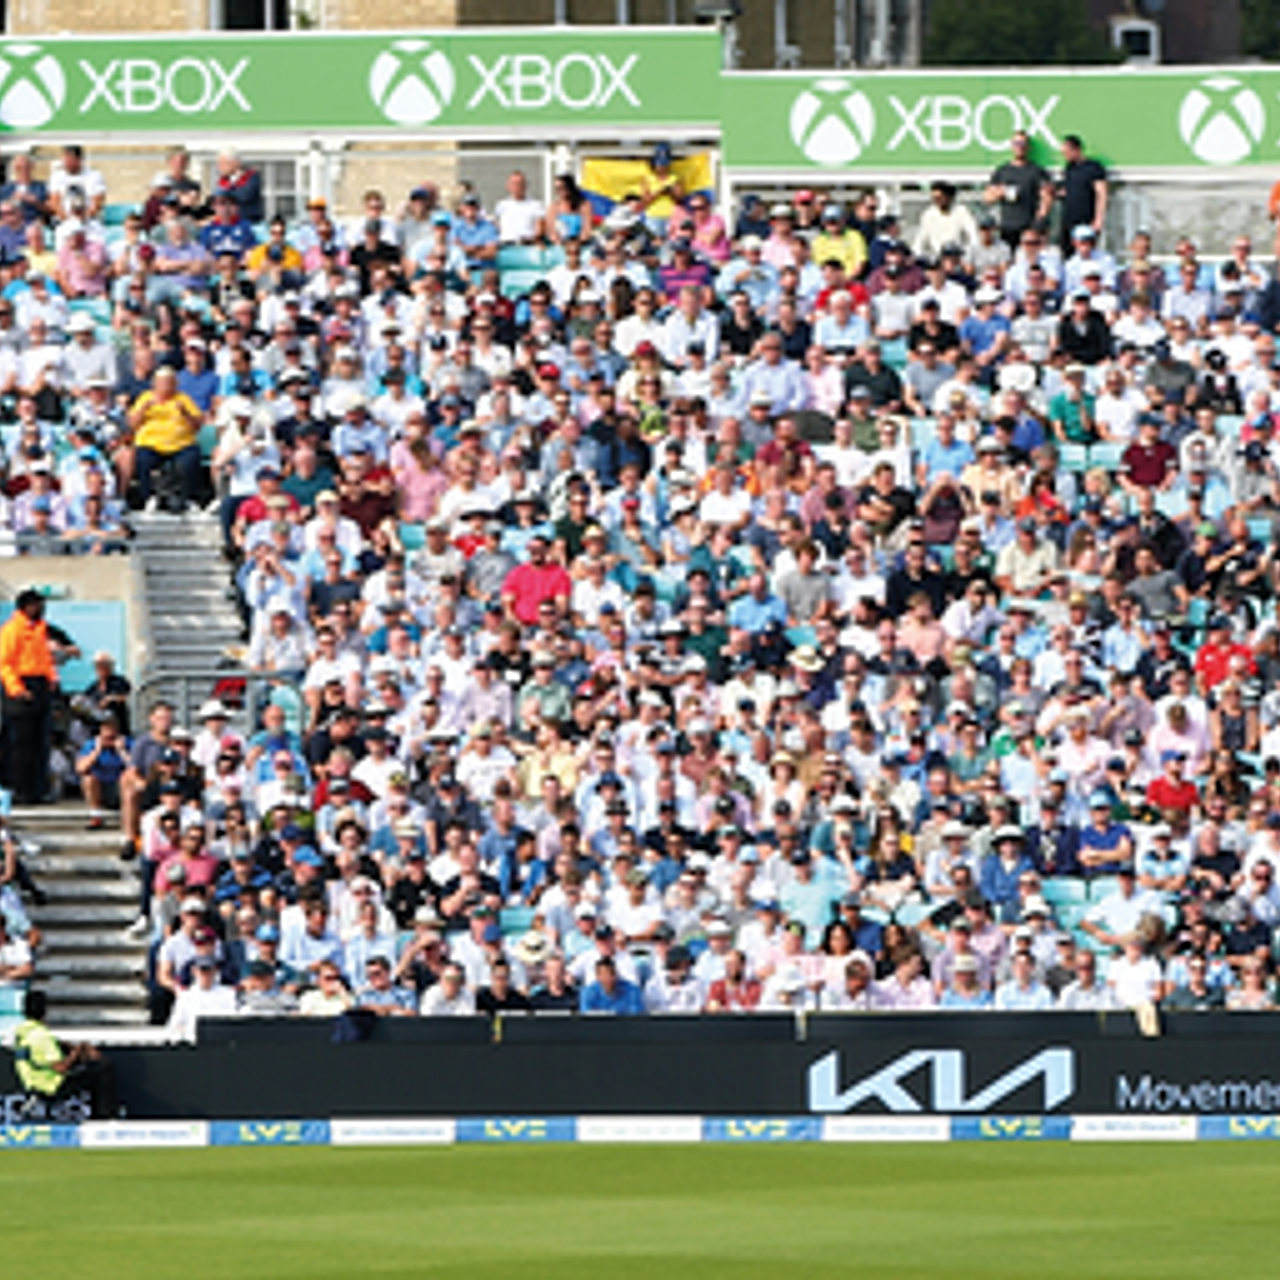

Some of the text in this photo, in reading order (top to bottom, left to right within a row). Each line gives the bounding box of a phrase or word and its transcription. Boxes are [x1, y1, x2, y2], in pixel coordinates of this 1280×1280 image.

[78, 58, 252, 113] XBOX
[466, 54, 642, 109] XBOX
[886, 95, 1062, 151] XBOX
